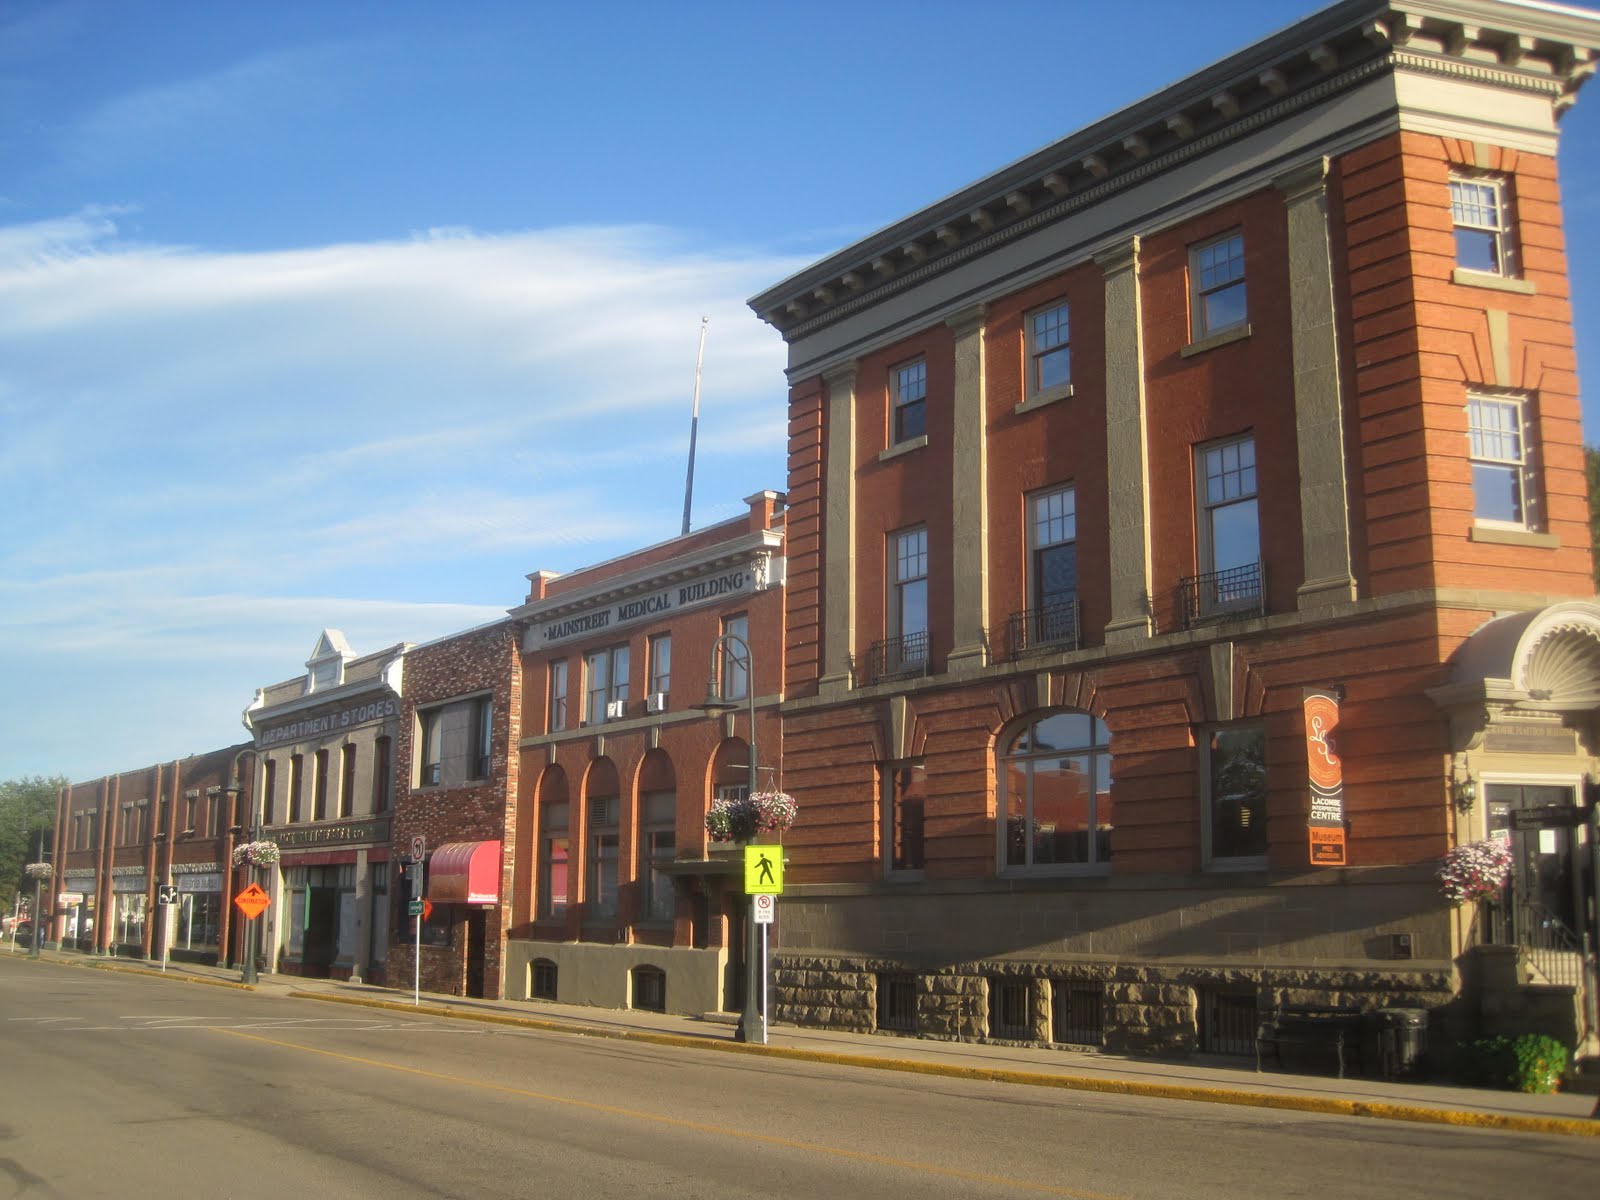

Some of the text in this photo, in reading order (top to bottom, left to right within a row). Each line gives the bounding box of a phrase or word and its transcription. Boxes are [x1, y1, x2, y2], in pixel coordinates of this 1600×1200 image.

[548, 572, 744, 641] MAINSTREET MEDICAL BUILDING
[262, 700, 393, 744] DEPARTMENT STORES
[1311, 796, 1341, 806] LACOMBE
[1311, 811, 1341, 820] CENTRE
[1312, 831, 1343, 841] Museum
[237, 897, 270, 905] CONSTRUCTION
